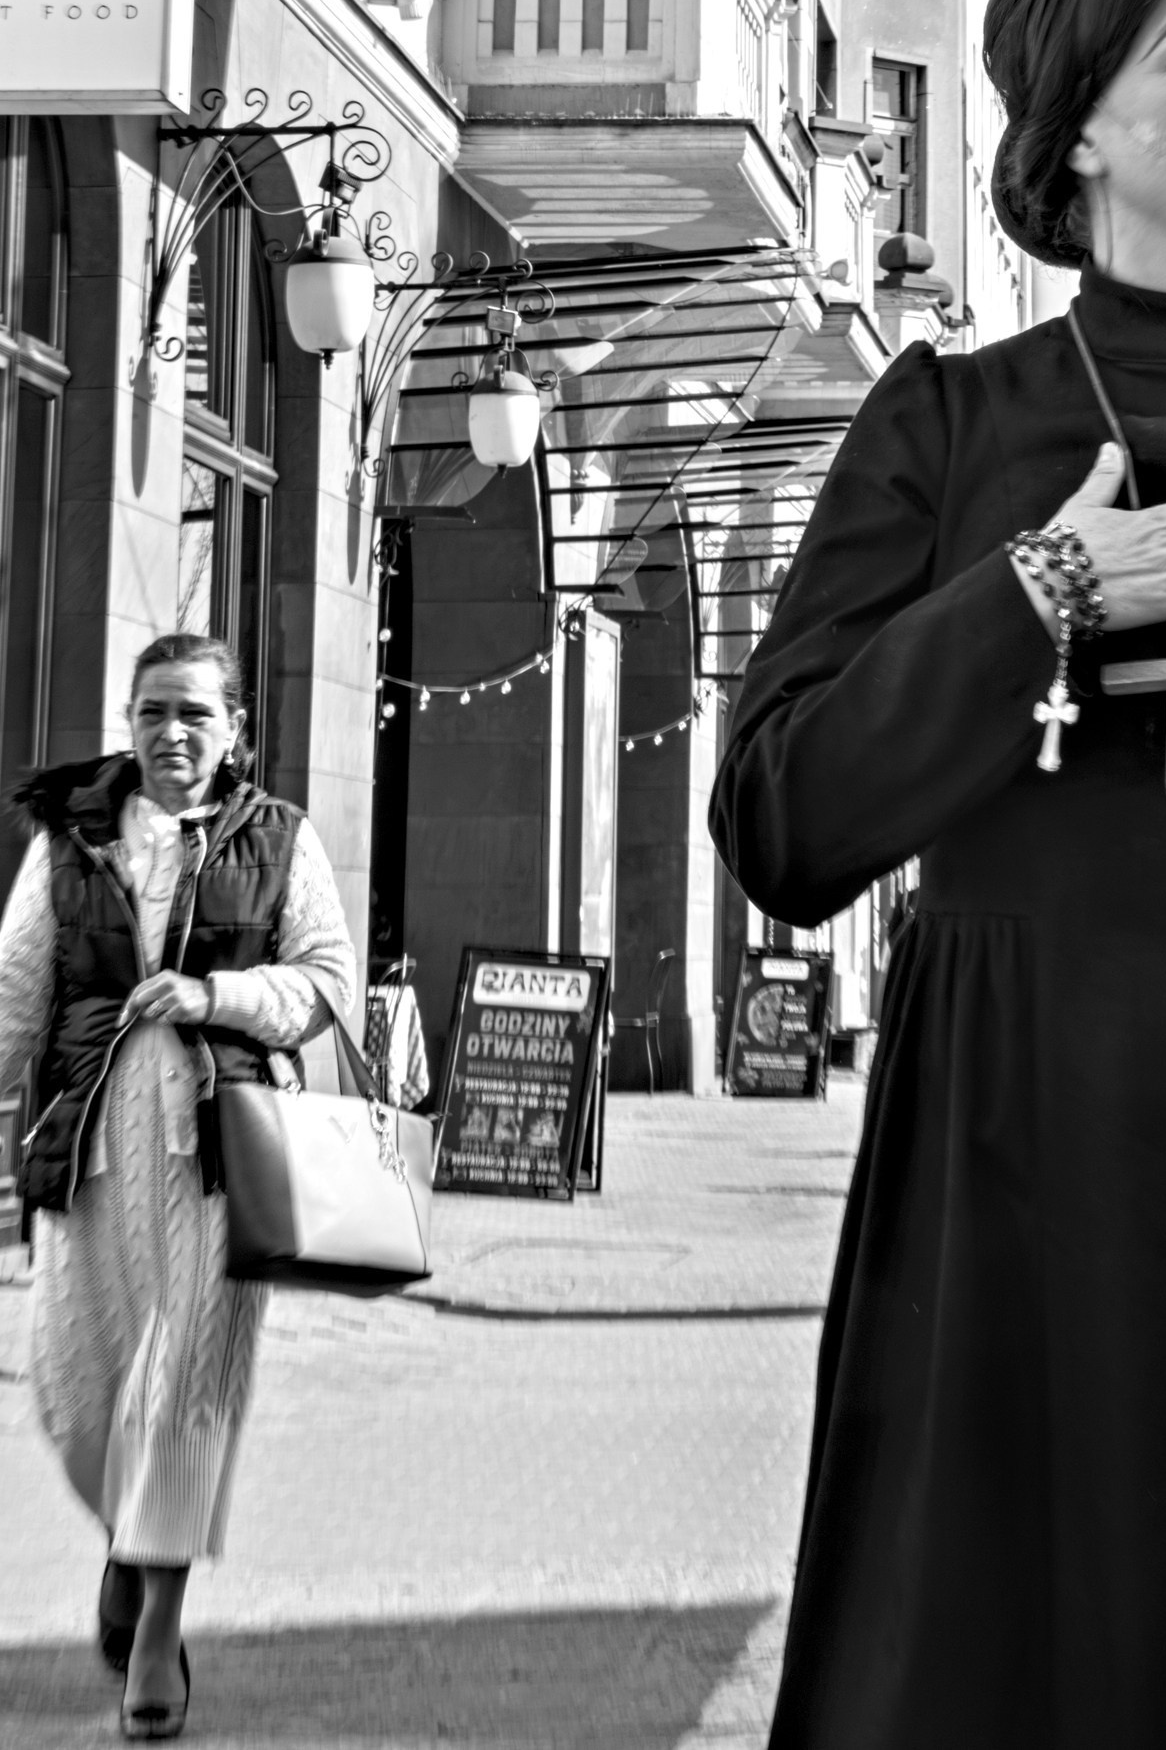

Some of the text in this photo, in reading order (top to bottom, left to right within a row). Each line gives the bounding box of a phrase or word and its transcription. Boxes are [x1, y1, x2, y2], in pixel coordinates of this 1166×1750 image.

[44, 4, 138, 20] FOOD
[480, 1008, 571, 1039] GODZINY
[466, 1032, 574, 1065] OTWARCIA
